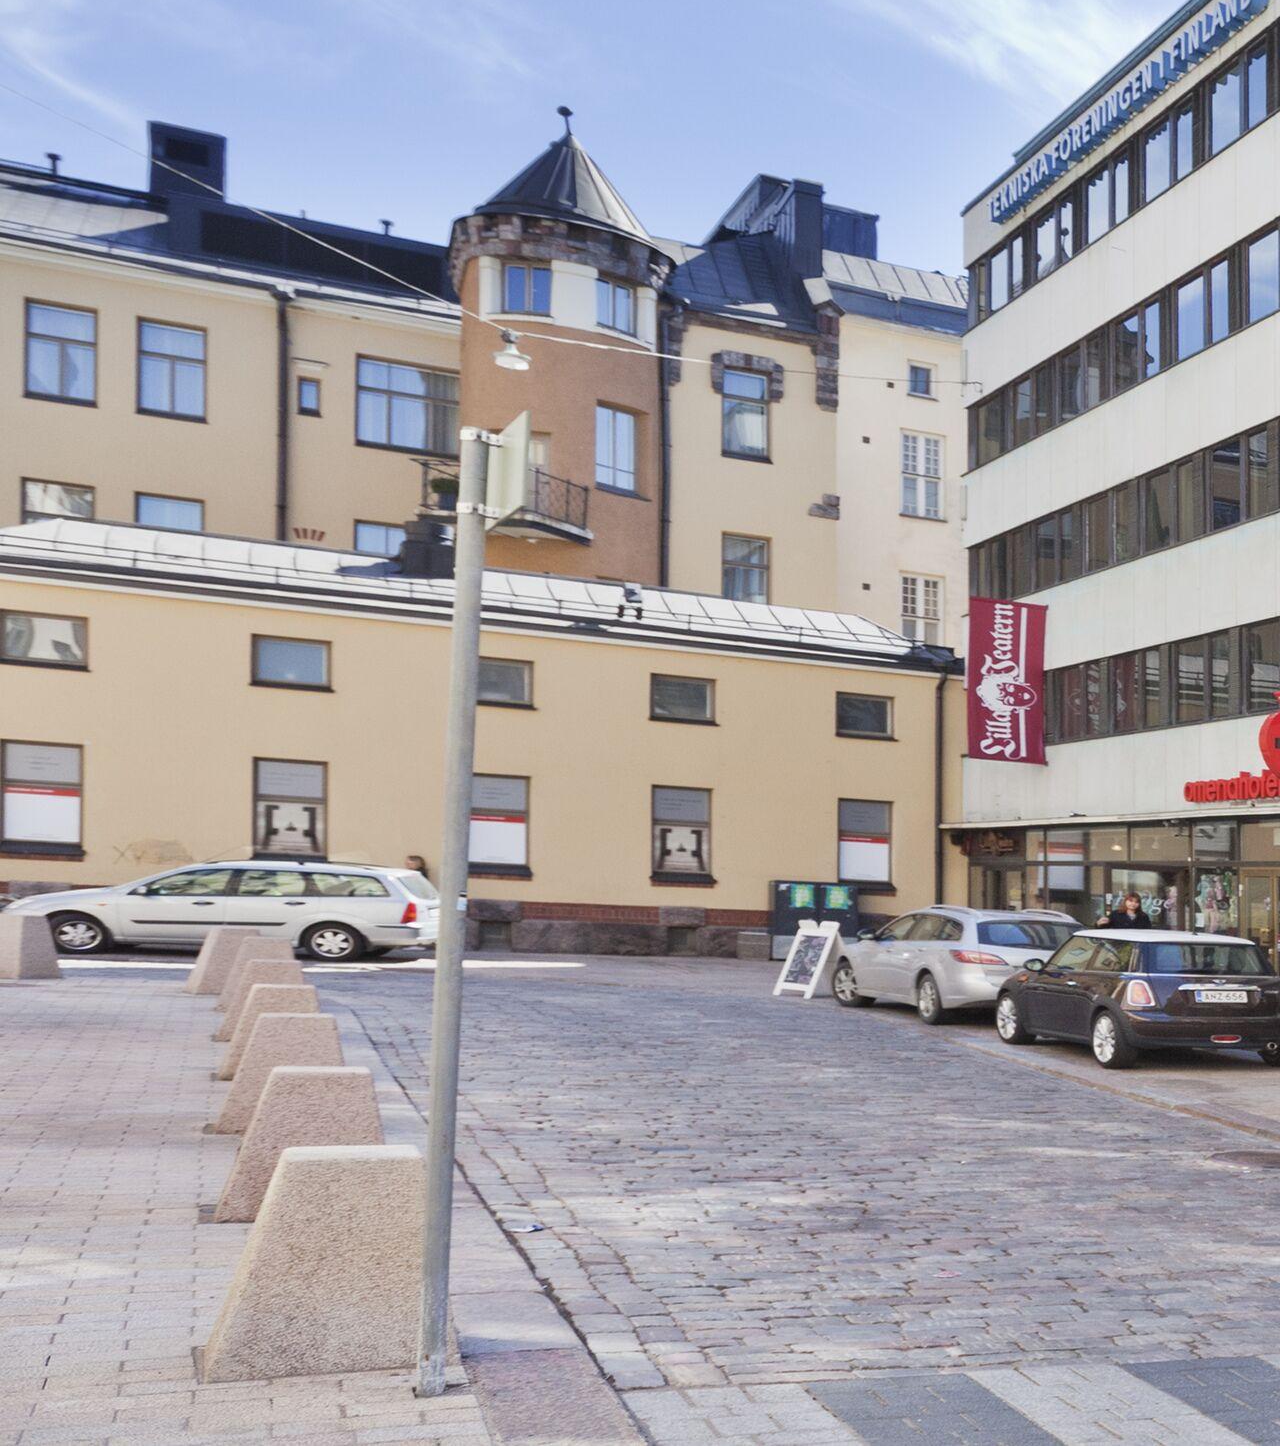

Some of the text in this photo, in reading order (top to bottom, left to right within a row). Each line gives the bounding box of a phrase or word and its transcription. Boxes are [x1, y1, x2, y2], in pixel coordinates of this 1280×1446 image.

[988, 154, 1048, 218] TEKNISKA
[1051, 61, 1151, 169] FÖRENINGEN
[981, 603, 1019, 680] Teatern
